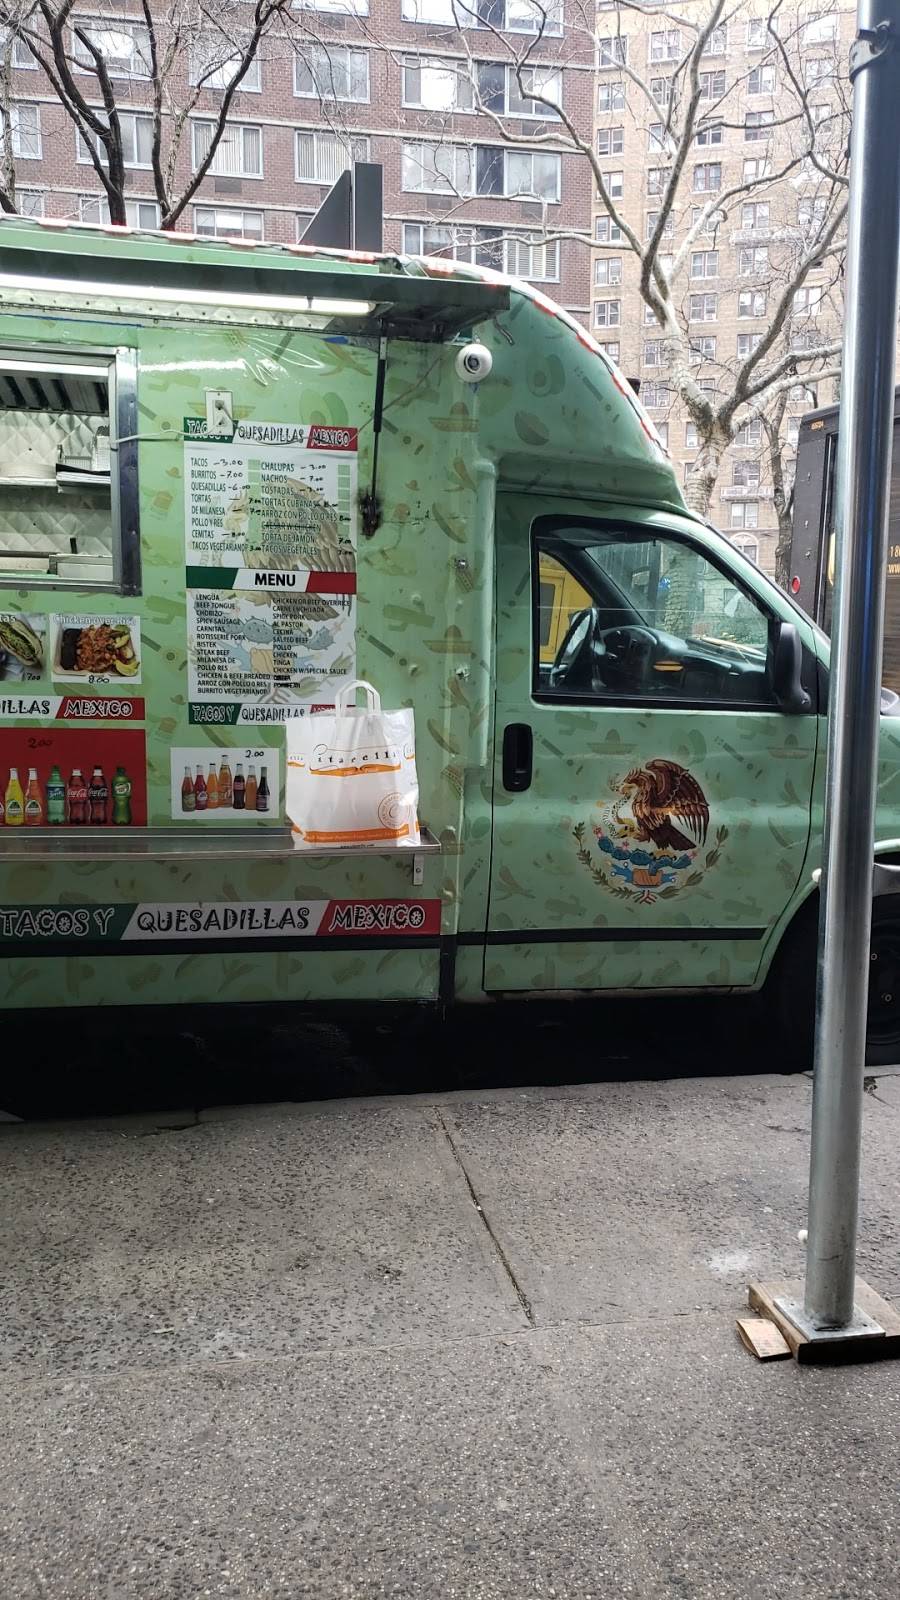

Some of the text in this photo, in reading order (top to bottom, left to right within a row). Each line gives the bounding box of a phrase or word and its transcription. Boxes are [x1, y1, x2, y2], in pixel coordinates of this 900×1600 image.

[238, 426, 304, 444] QUESADILLAS
[311, 429, 350, 447] MEXICO
[191, 457, 208, 467] TACOS
[261, 461, 295, 472] CHALUPAS
[191, 469, 217, 480] BURRITOS
[261, 474, 288, 484] NACHOS
[191, 481, 226, 492] QUESADILLAS
[261, 486, 294, 496] TOSTADAS
[191, 494, 212, 503] TORTAS
[261, 497, 286, 507] TORTAS
[191, 506, 199, 515] DE
[199, 506, 226, 516] MILANESA
[261, 509, 283, 519] ARROZ
[284, 510, 297, 519] CON
[191, 518, 209, 527] POLLO
[213, 518, 224, 528] RES
[191, 529, 215, 539] CEMITAS
[261, 532, 282, 542] TORTA
[283, 533, 293, 543] DE
[192, 541, 209, 551] TACOS
[261, 544, 285, 554] TACOS
[254, 573, 296, 587] MENU
[196, 601, 236, 610] BEEF TONGUE
[272, 597, 298, 605] CHICKEN
[196, 609, 223, 617] CHORIZO
[53, 613, 91, 625] Chicken
[196, 617, 241, 626] SPICY SAUSAGE
[196, 625, 226, 633] CARNITAS
[281, 621, 304, 629] PASTOR
[196, 633, 230, 641] ROTISSERIE
[272, 636, 295, 644] SALTED
[197, 687, 223, 695] BURRITO
[0, 699, 133, 718] ILLAS MEXICO
[192, 704, 225, 723] TACOS
[225, 704, 235, 723] Y
[0, 903, 426, 937] TACOS Y QUESADILLAS MEXICO
